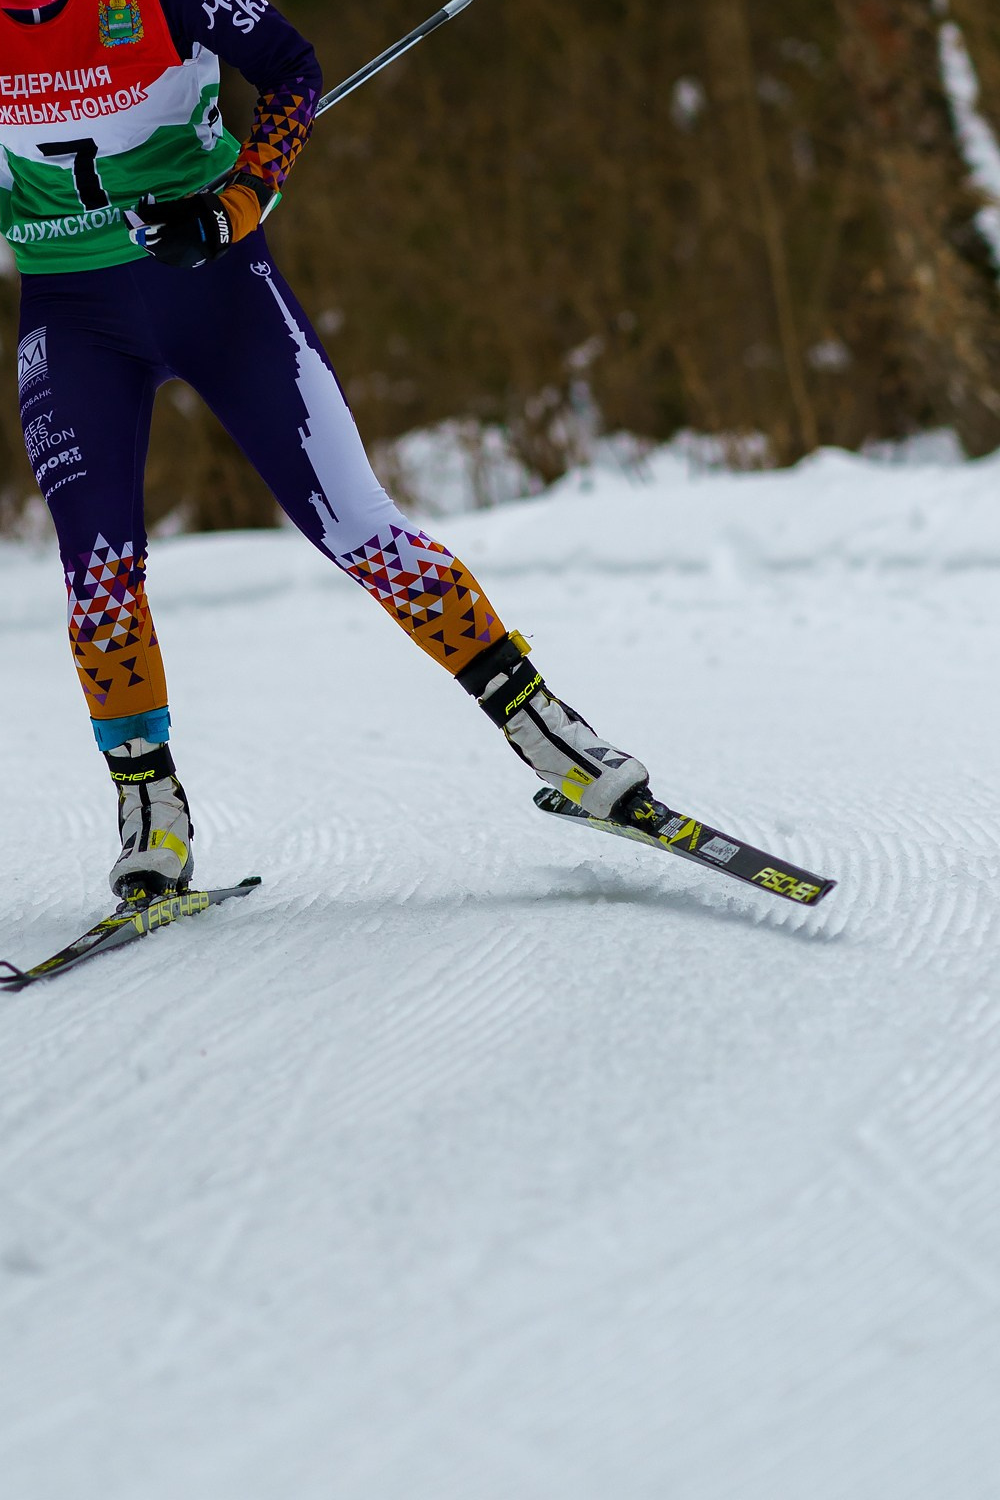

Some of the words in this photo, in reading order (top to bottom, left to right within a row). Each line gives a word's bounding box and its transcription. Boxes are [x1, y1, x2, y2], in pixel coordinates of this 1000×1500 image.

[70, 82, 149, 120] ГОНОК
[36, 137, 112, 212] 7
[29, 427, 75, 466] RITION
[751, 867, 821, 903] FISCHER
